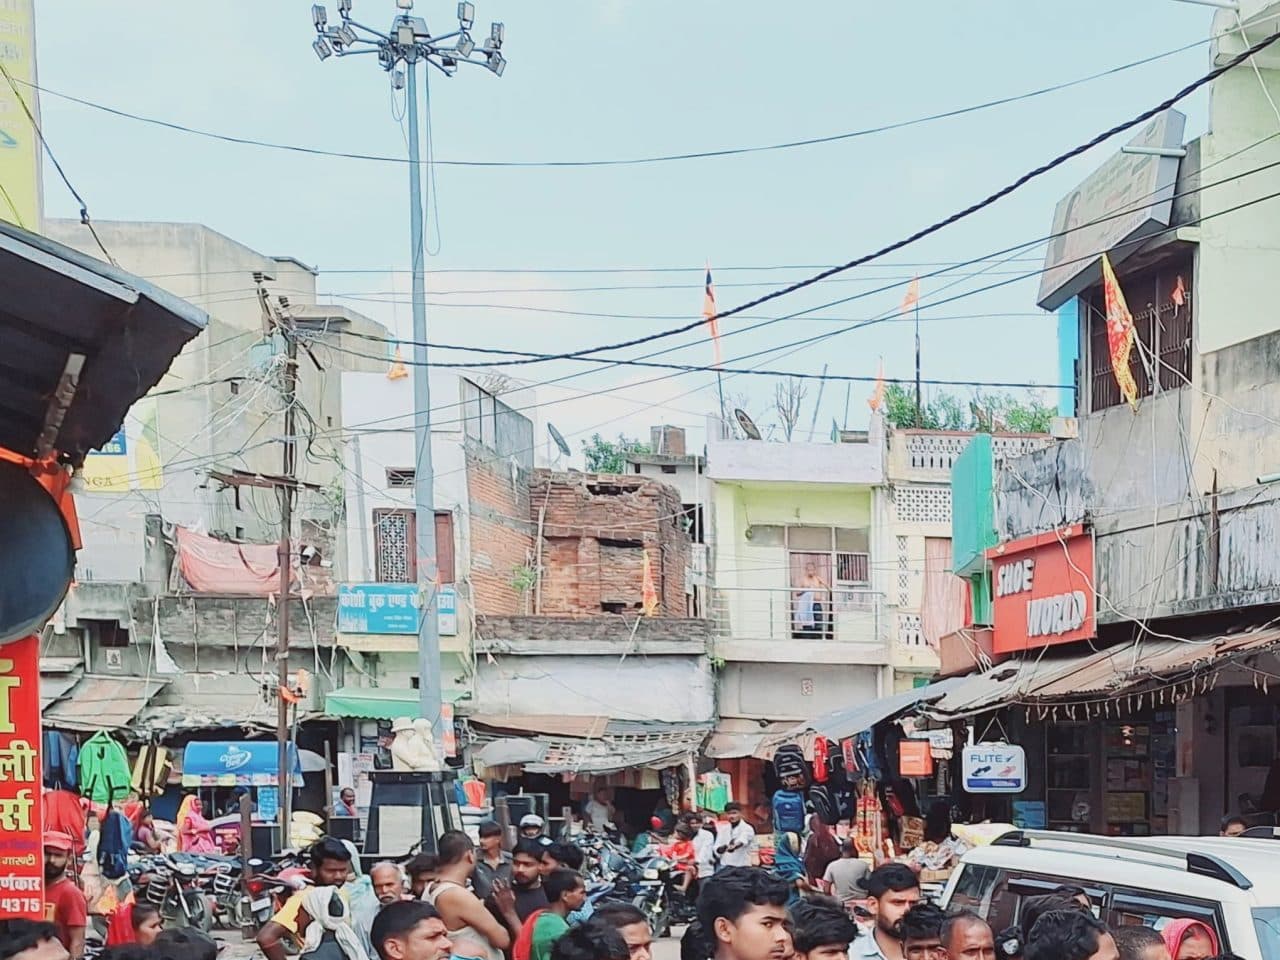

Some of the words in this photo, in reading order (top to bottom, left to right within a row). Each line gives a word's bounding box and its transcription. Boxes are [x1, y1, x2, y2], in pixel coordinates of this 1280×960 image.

[997, 558, 1034, 597] SHOE
[1027, 590, 1088, 638] WORLD
[970, 754, 1003, 764] FLITE
[0, 897, 41, 913] 4375
